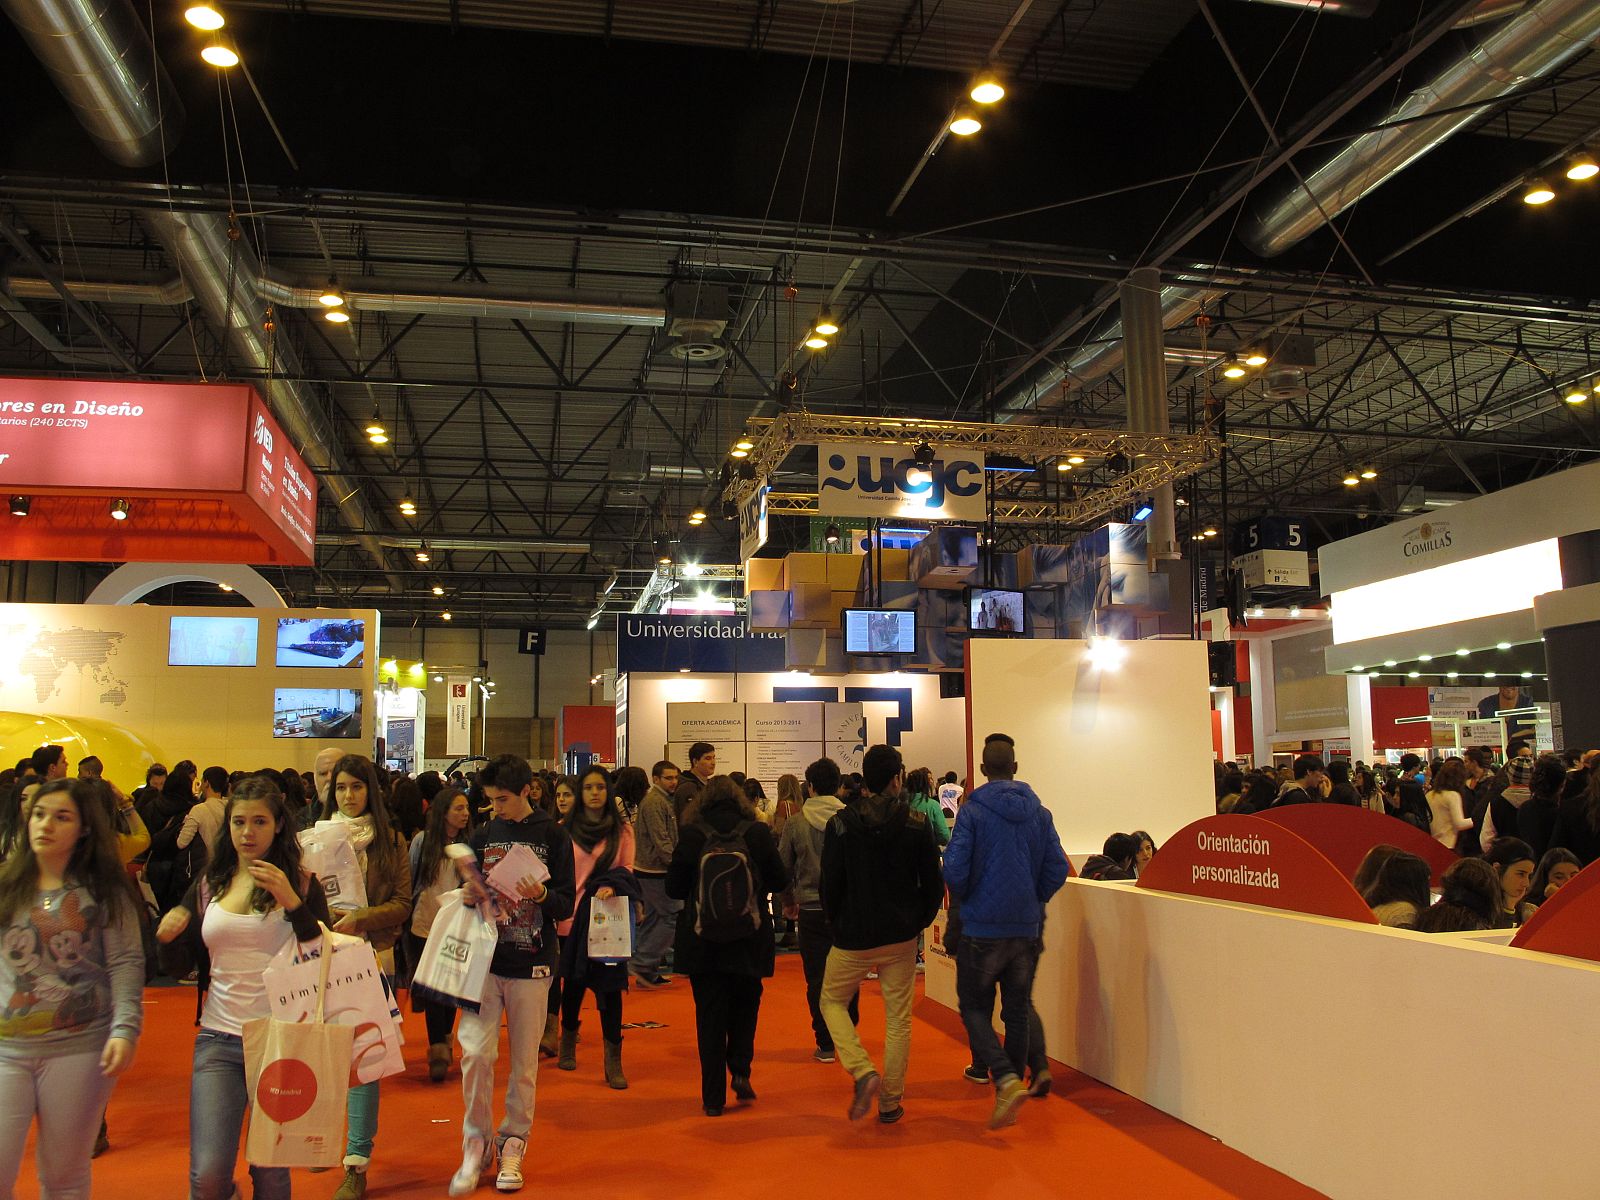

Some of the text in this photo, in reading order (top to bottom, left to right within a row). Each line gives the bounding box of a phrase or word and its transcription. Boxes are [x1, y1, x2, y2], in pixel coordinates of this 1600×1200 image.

[41, 402, 65, 414] en
[72, 400, 144, 417] Diseño
[30, 418, 54, 428] (240
[56, 418, 88, 429] ECTS)
[856, 455, 983, 508] ucjc
[1249, 524, 1259, 548] 5
[1288, 524, 1301, 547] 5
[1200, 600, 1207, 611] de
[526, 631, 539, 651] F
[626, 620, 745, 639] Universidad
[1197, 831, 1270, 856] Orientación
[1192, 864, 1280, 889] personalizada
[279, 967, 373, 1006] gimbernat
